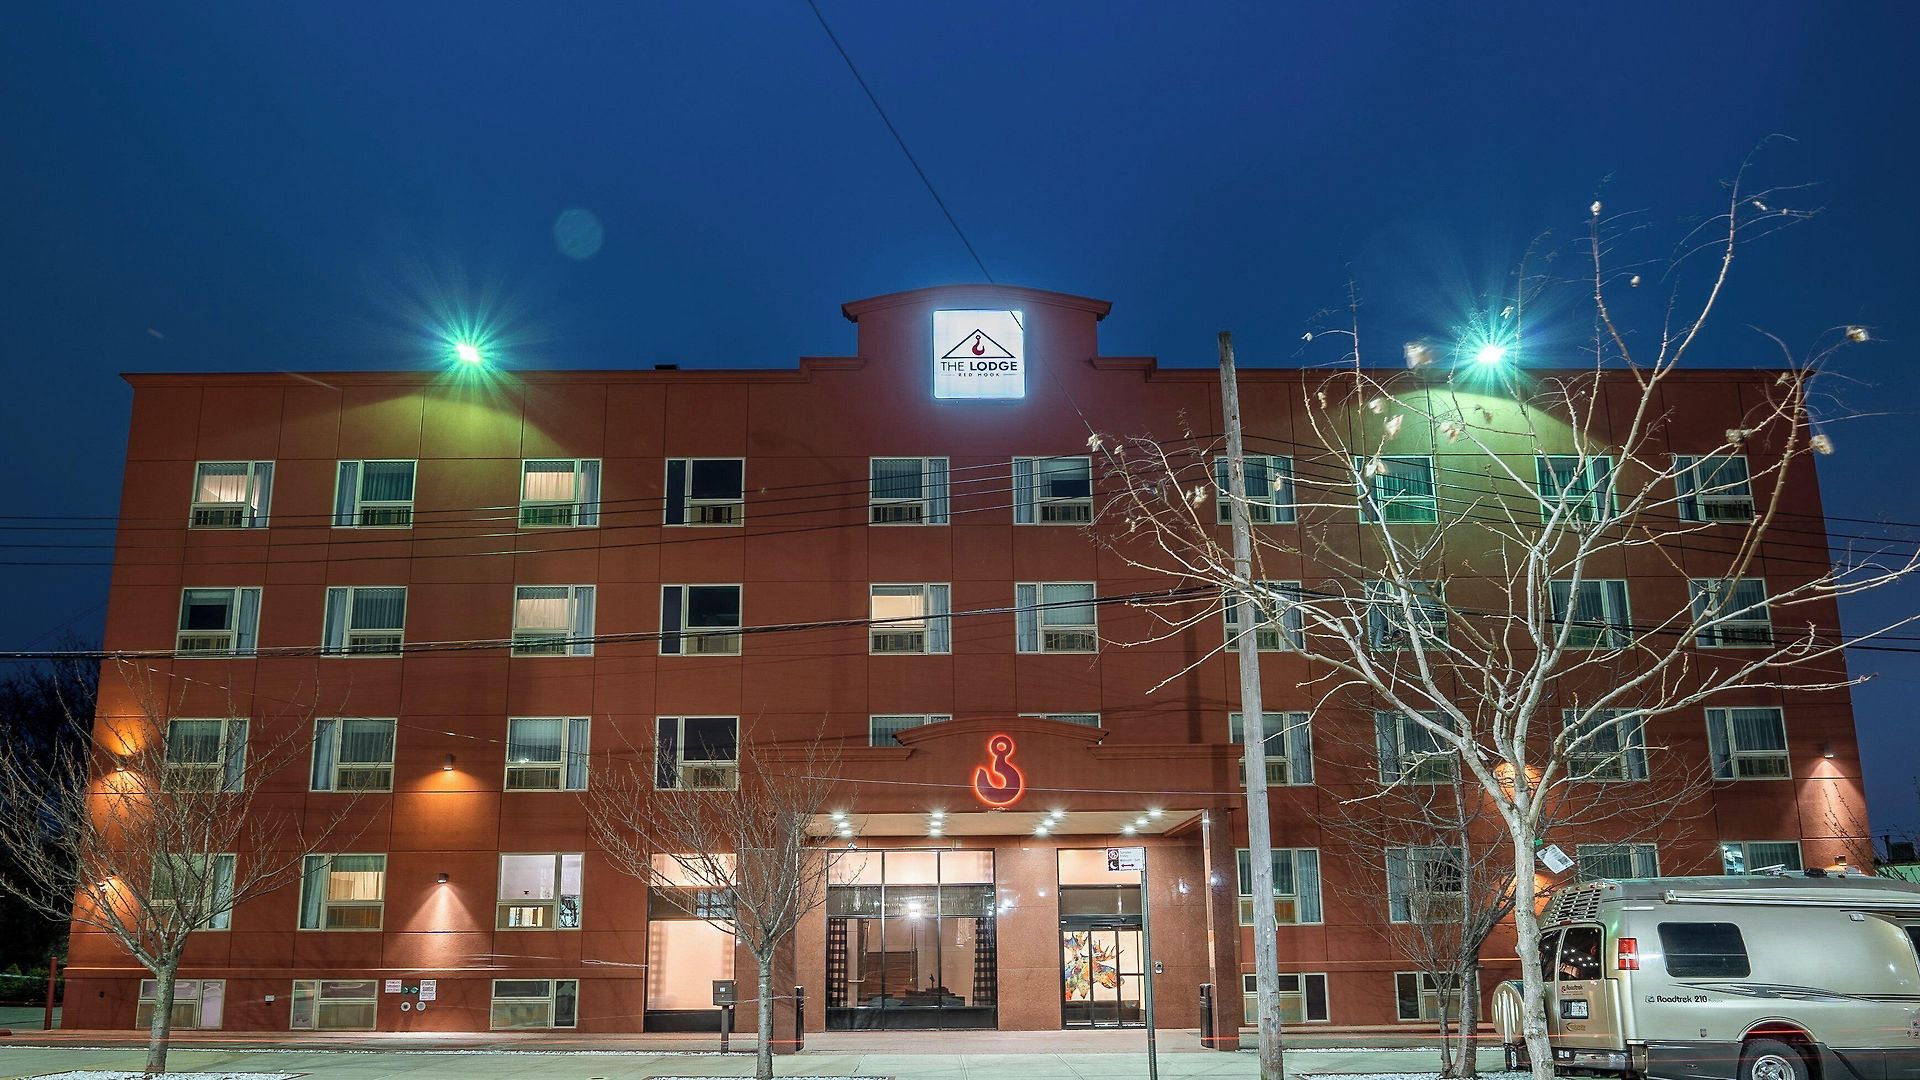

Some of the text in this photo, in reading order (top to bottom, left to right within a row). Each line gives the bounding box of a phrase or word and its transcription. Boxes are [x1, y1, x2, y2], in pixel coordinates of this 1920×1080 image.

[940, 361, 1018, 372] THE LODGE
[1656, 995, 1693, 1003] Roadtrek
[1694, 995, 1708, 1003] 210
